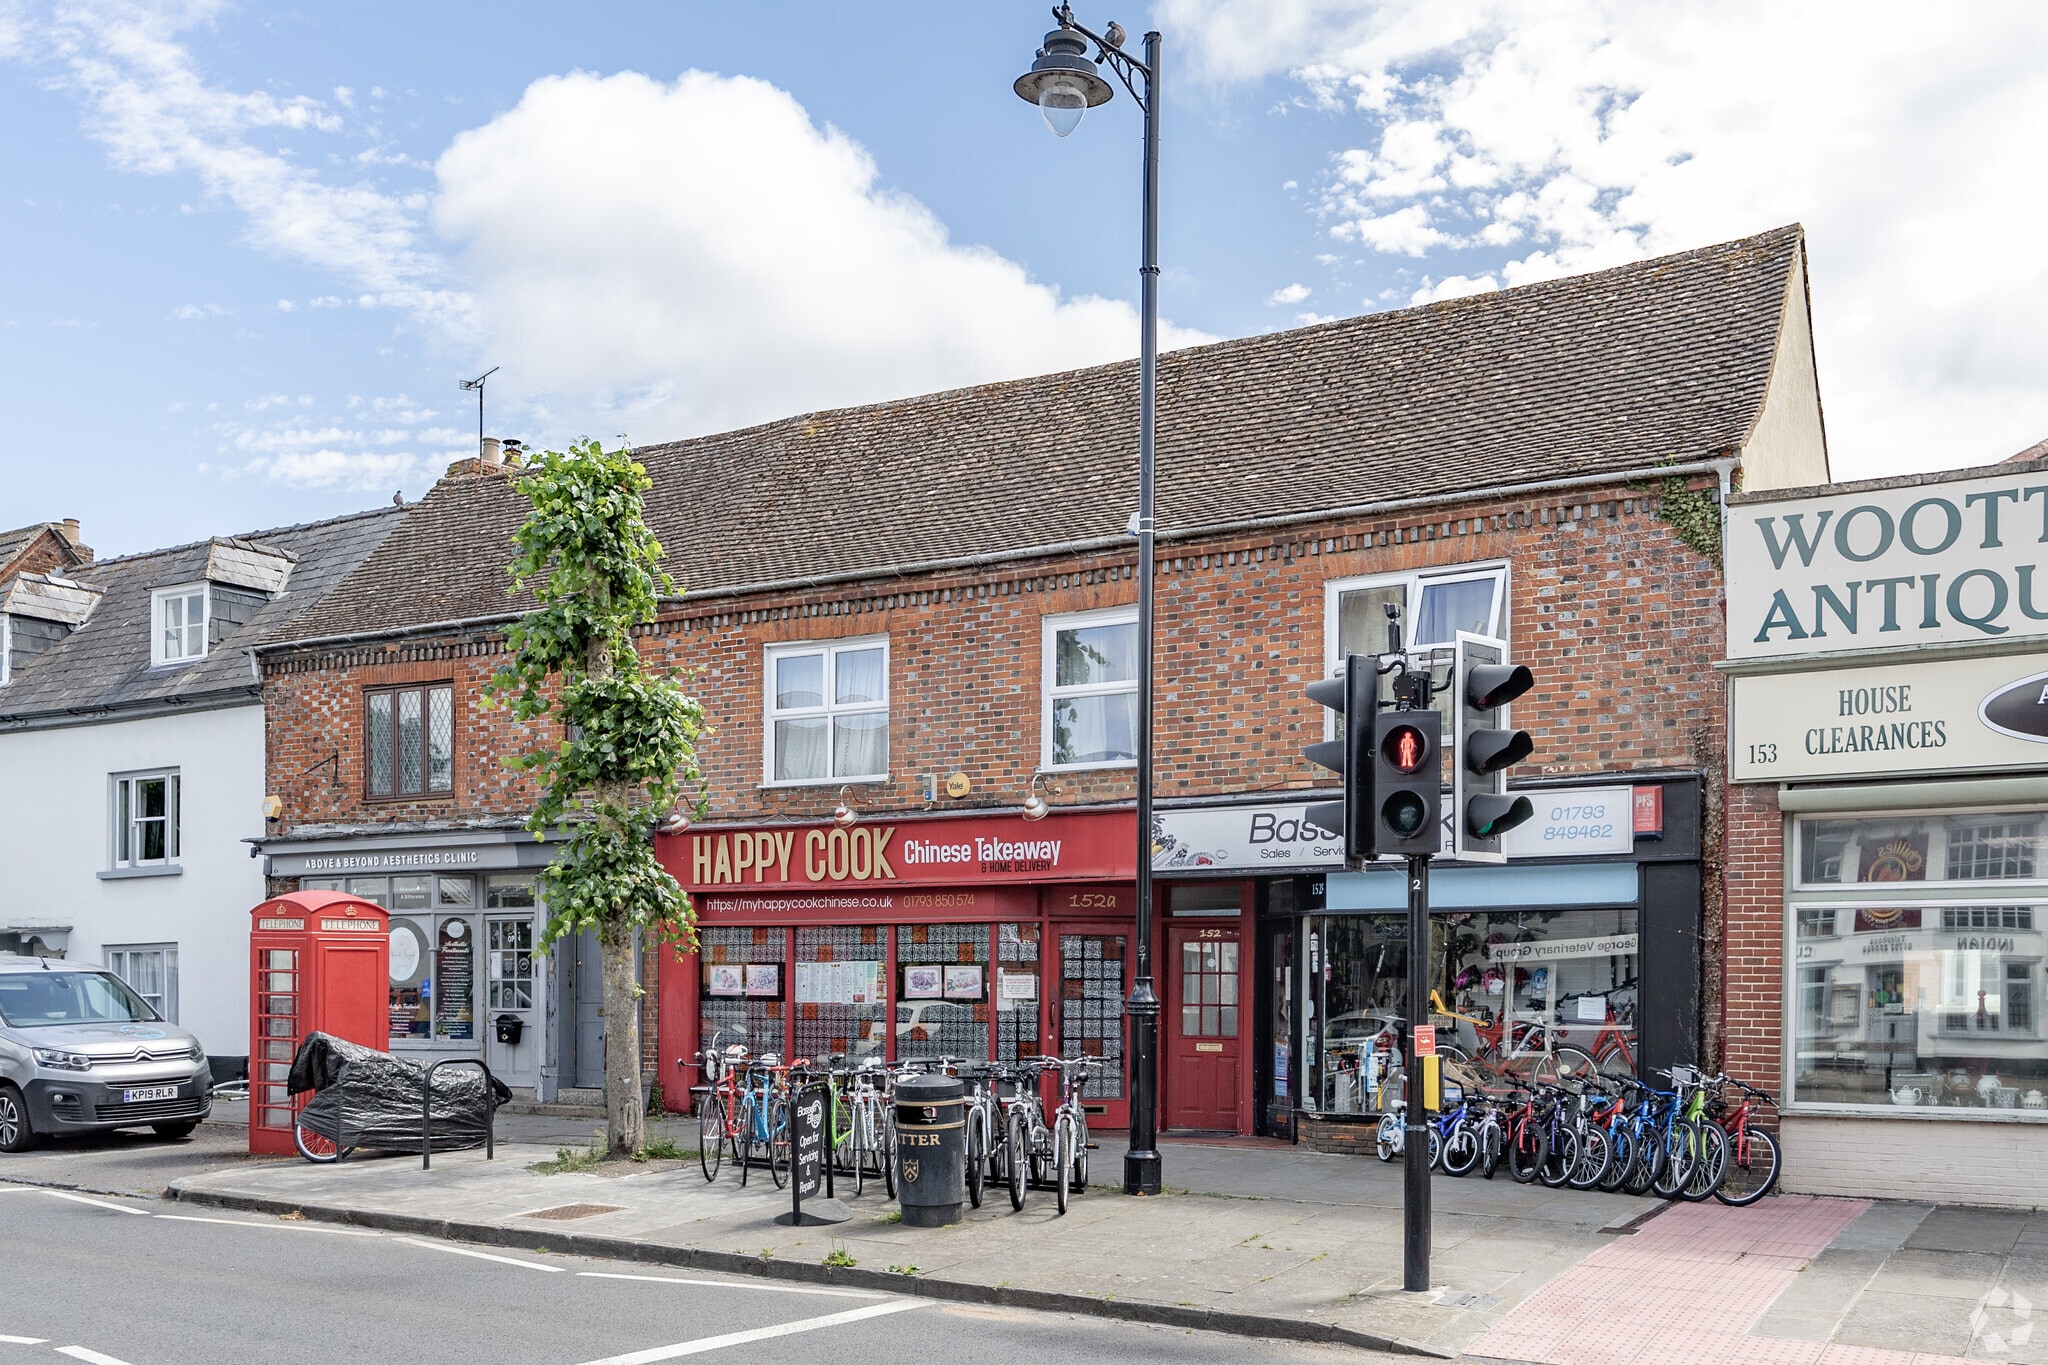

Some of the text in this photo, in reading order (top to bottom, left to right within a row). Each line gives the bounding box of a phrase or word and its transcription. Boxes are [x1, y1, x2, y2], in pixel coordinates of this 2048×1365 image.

[1838, 684, 1912, 716] HOUSE
[1805, 720, 1947, 755] CLEARANCES
[1749, 743, 1778, 764] 153
[948, 782, 964, 791] Yale
[1551, 805, 1605, 821] 01793
[1543, 824, 1613, 841] 849462
[693, 827, 897, 885] HAPPY COOK
[904, 837, 1062, 866] Chinese Takeaway
[1260, 848, 1291, 859] Sales
[305, 851, 478, 869] ABOVE & BEYOND AESTHETICS CLINIC
[981, 860, 1052, 873] & HOME DELIVERY
[1413, 879, 1421, 890] 2
[707, 894, 975, 913] https://myhappycookchinese.co.uk 01793 850 574
[1069, 894, 1116, 908] 152a
[262, 920, 303, 928] TELEPHONE
[324, 920, 378, 929] TELEPHONE
[1199, 929, 1222, 938] 152
[132, 1088, 174, 1100] KP19 RLR
[799, 1132, 820, 1148] Open for
[898, 1133, 941, 1146] ITTER
[799, 1150, 819, 1166] Servicing
[806, 1165, 811, 1176] &
[799, 1178, 815, 1194] Repairs
